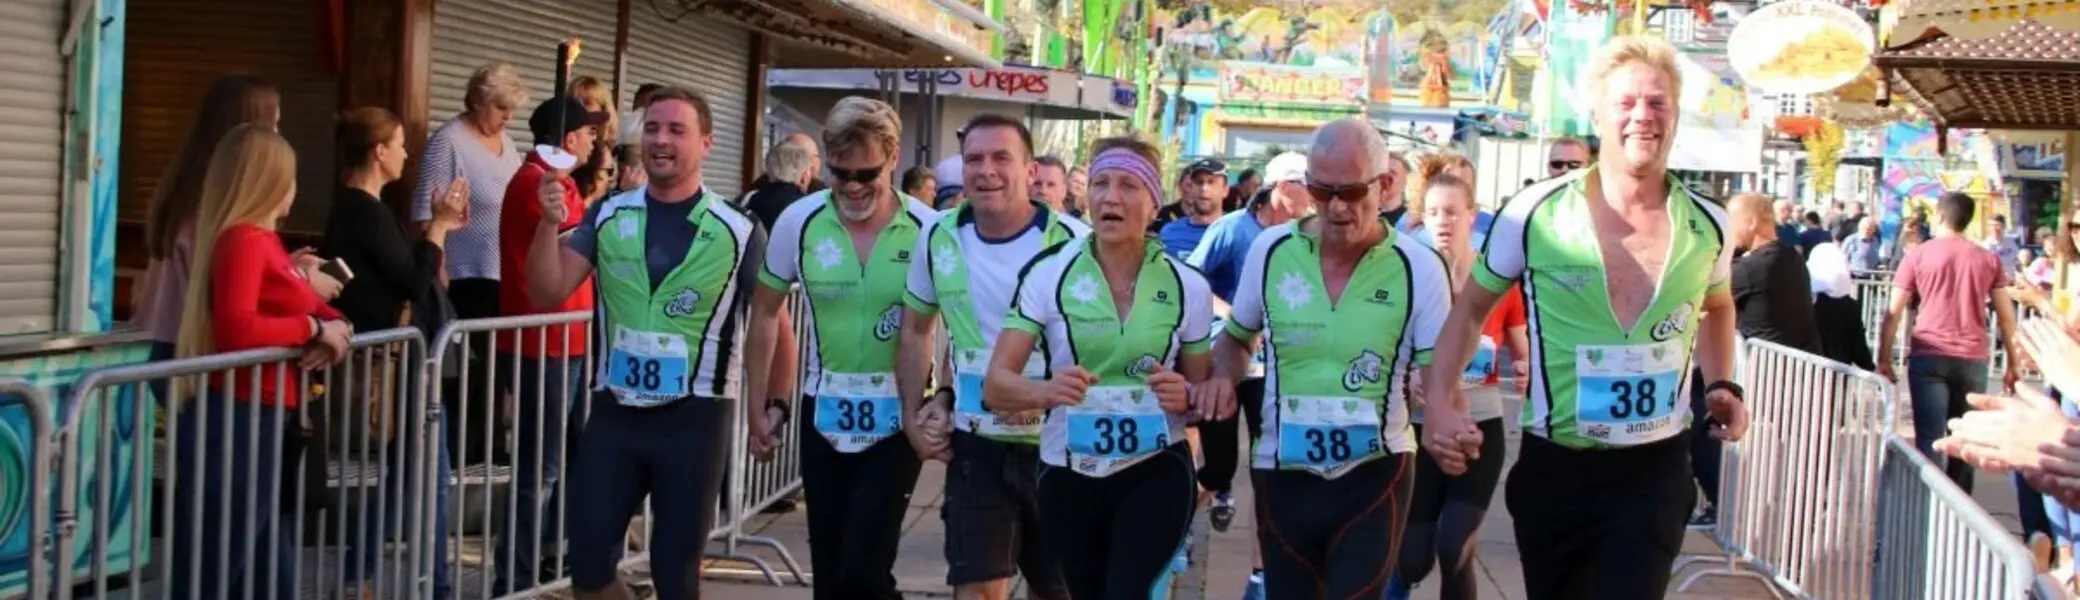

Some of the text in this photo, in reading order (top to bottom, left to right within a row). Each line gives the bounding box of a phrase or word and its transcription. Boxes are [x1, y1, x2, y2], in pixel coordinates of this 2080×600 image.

[625, 356, 683, 391] 38 1
[837, 399, 899, 432] 38 3
[1609, 378, 1656, 419] 38
[1094, 417, 1168, 455] 38 6
[1305, 428, 1379, 463] 38 5
